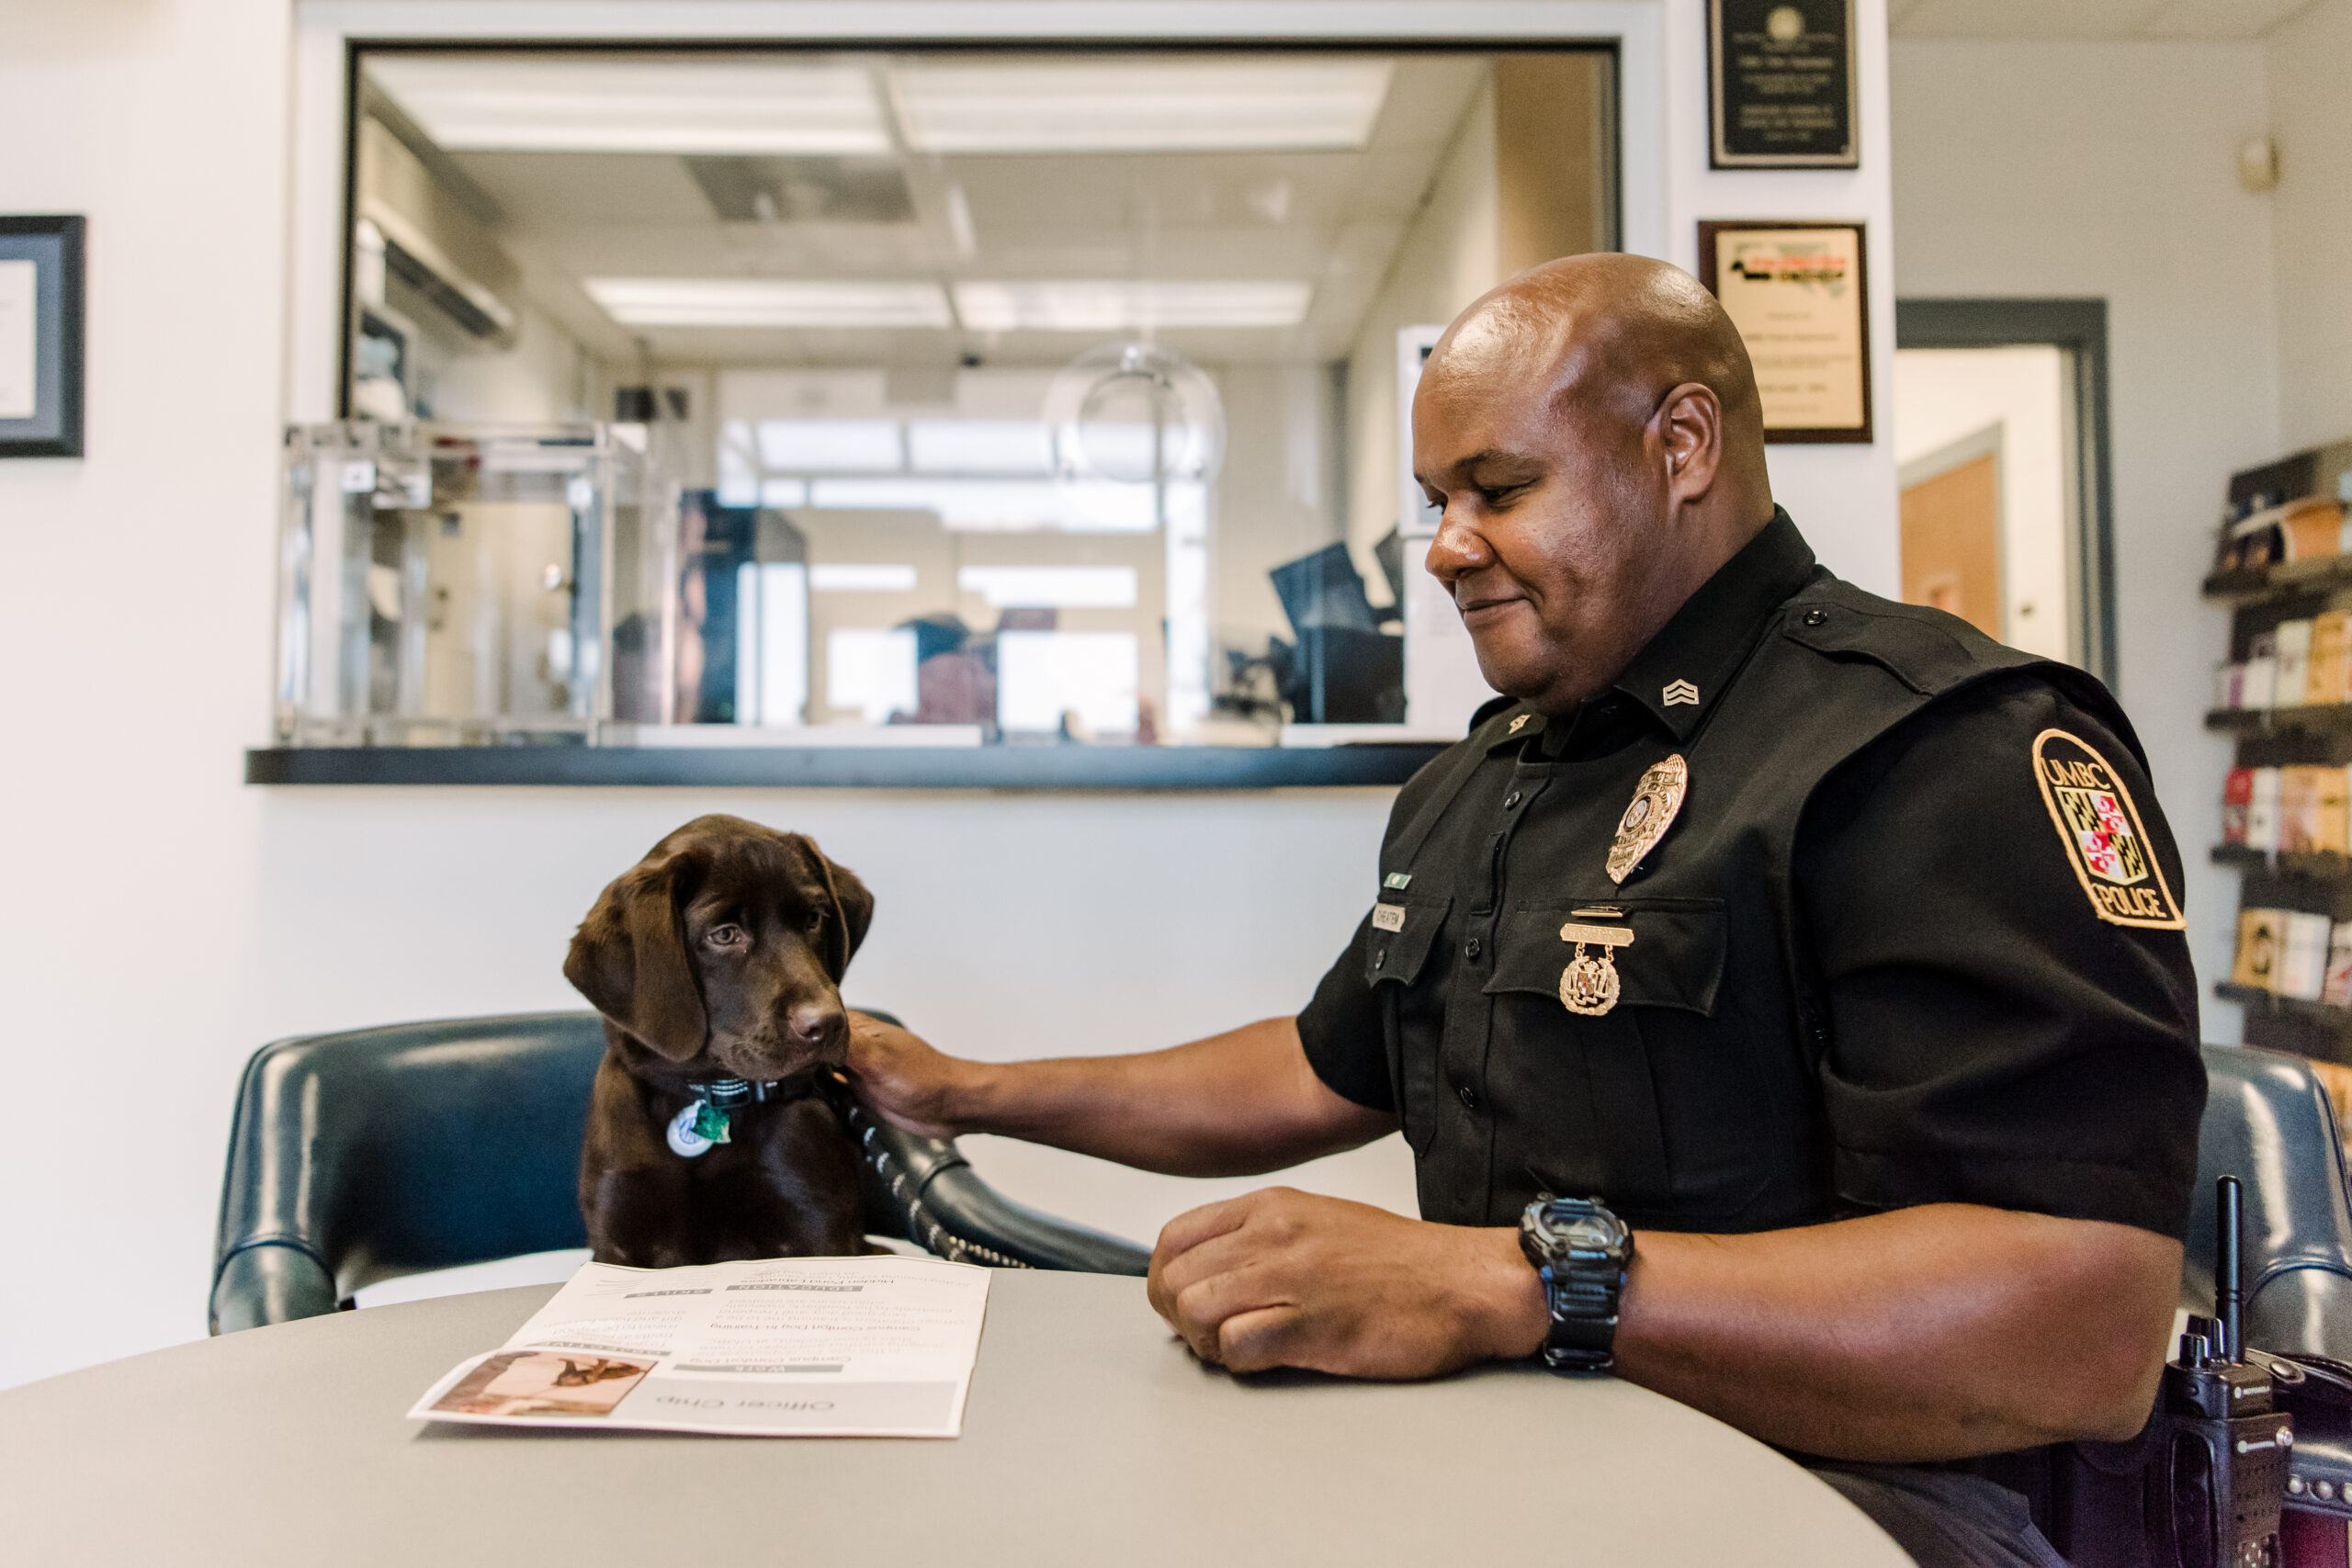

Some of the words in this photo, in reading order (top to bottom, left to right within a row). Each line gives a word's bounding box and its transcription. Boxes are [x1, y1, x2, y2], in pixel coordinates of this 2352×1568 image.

[2041, 757, 2110, 789] UMBC
[2091, 883, 2166, 918] POLICE
[656, 1395, 724, 1410] Chip
[735, 1401, 835, 1411] Officer
